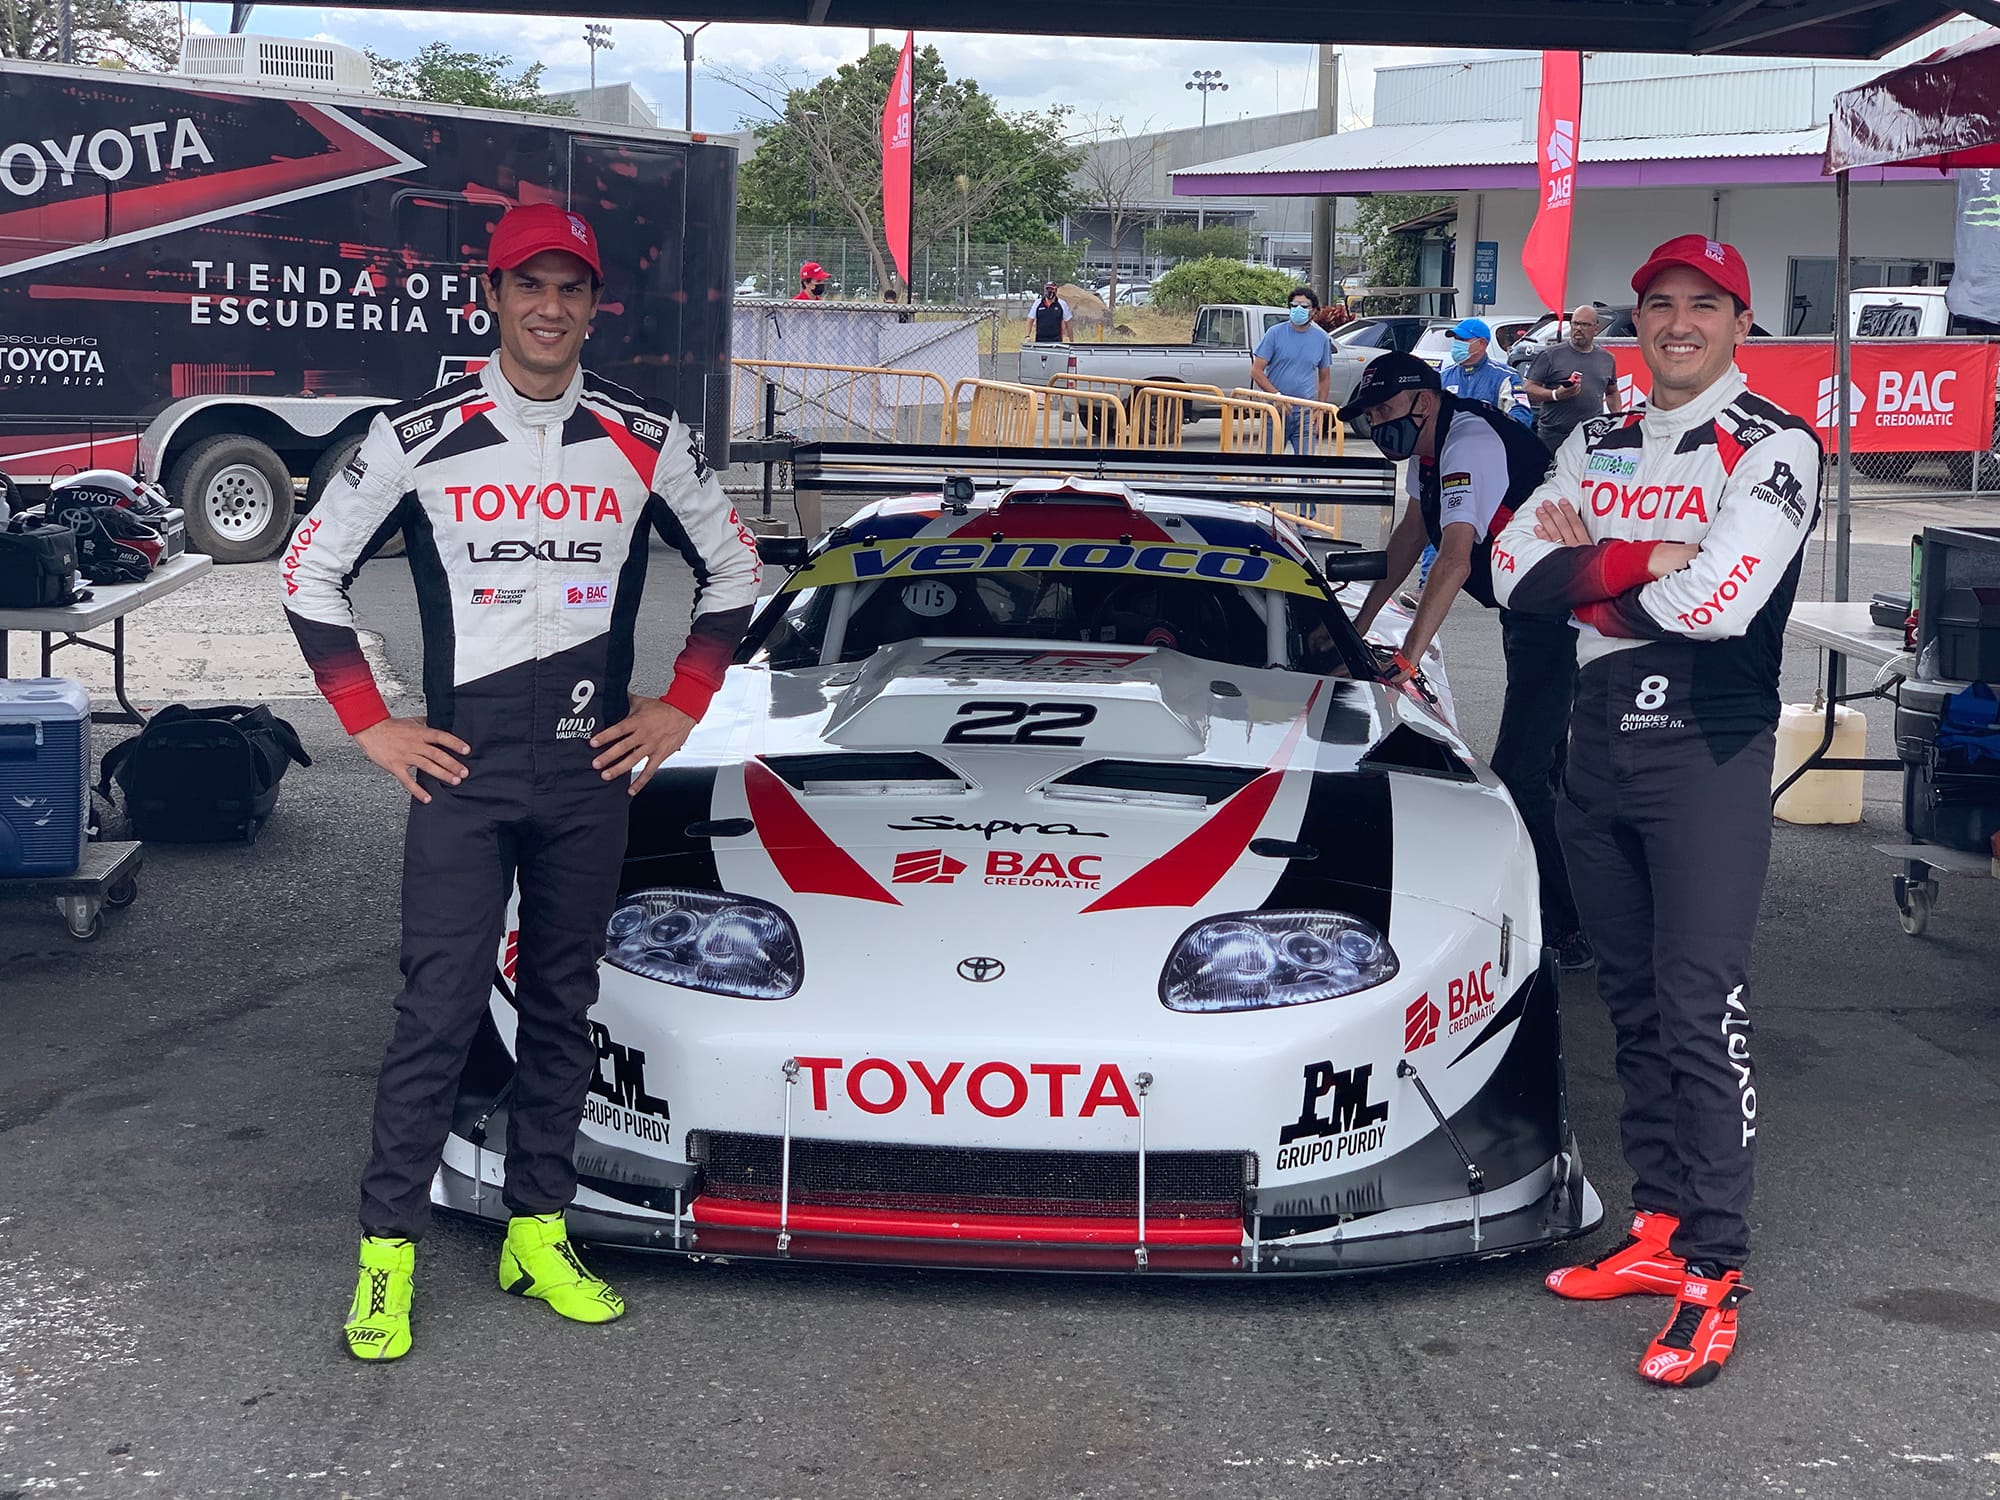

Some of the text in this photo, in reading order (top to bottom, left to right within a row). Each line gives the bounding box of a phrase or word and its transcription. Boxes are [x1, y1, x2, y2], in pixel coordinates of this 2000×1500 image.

[192, 261, 376, 298] TIENDA
[190, 296, 428, 333] ESCUDERÍA
[63, 377, 104, 387] RICA
[1876, 370, 1957, 412] BAC
[403, 419, 434, 439] OMP
[633, 422, 663, 439] OMP
[1875, 413, 1954, 427] CREDOMATIC
[445, 482, 623, 524] TOYOTA
[1750, 485, 1801, 530] PURDY MOTOR
[119, 552, 140, 561] MILO
[467, 540, 603, 563] LEXUS
[852, 541, 1272, 583] venoco
[471, 592, 493, 604] GR
[586, 585, 607, 599] BAC
[1678, 554, 1762, 631] TOYOTA
[571, 679, 596, 714] 9
[1635, 675, 1669, 710] 8
[556, 716, 596, 732] MILO
[942, 701, 1099, 747] 22
[1621, 713, 1669, 723] AMADEO
[887, 815, 1110, 841] Supra
[985, 850, 1103, 881] BAC
[984, 876, 1101, 890] CREDOMATIC
[1447, 961, 1495, 1022] BAC
[1448, 1001, 1496, 1038] CREDOMATIC
[794, 1056, 1140, 1118] TOYOTA
[624, 1112, 671, 1144] PURDY
[1276, 1125, 1387, 1171] GRUPO PURDY
[1685, 1283, 1708, 1298] OMP
[348, 1329, 387, 1343] OMP
[1646, 1353, 1680, 1374] OMP
